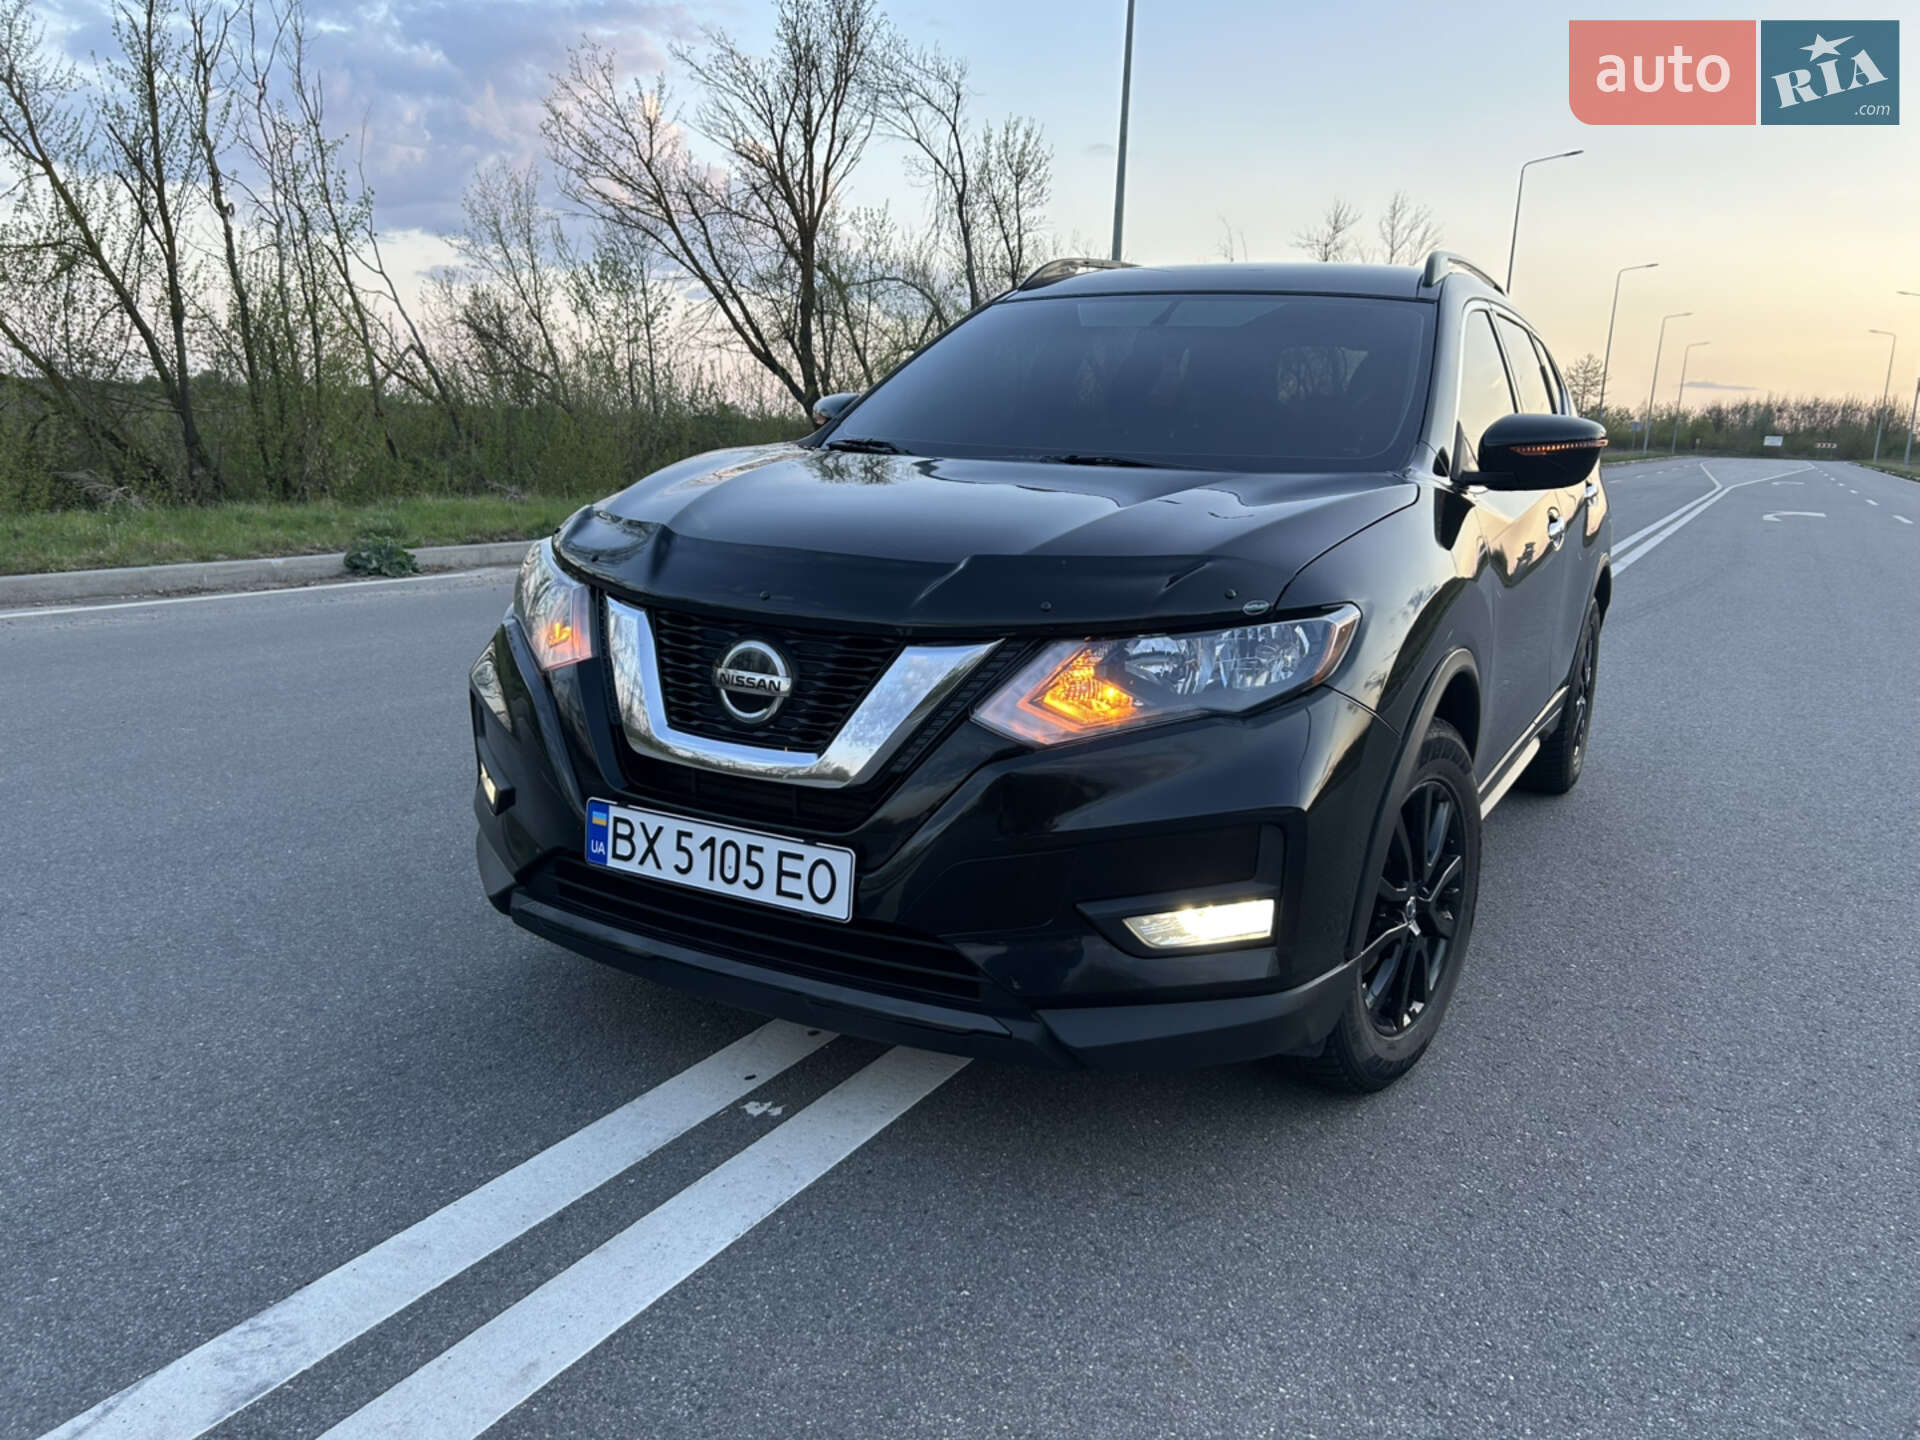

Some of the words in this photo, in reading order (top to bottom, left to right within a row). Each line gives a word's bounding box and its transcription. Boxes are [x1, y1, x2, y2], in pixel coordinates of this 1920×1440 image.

[719, 672, 782, 692] NISSAN
[591, 839, 606, 855] UA
[611, 816, 664, 870] BX
[673, 830, 764, 890] 5105
[776, 850, 837, 905] EO
